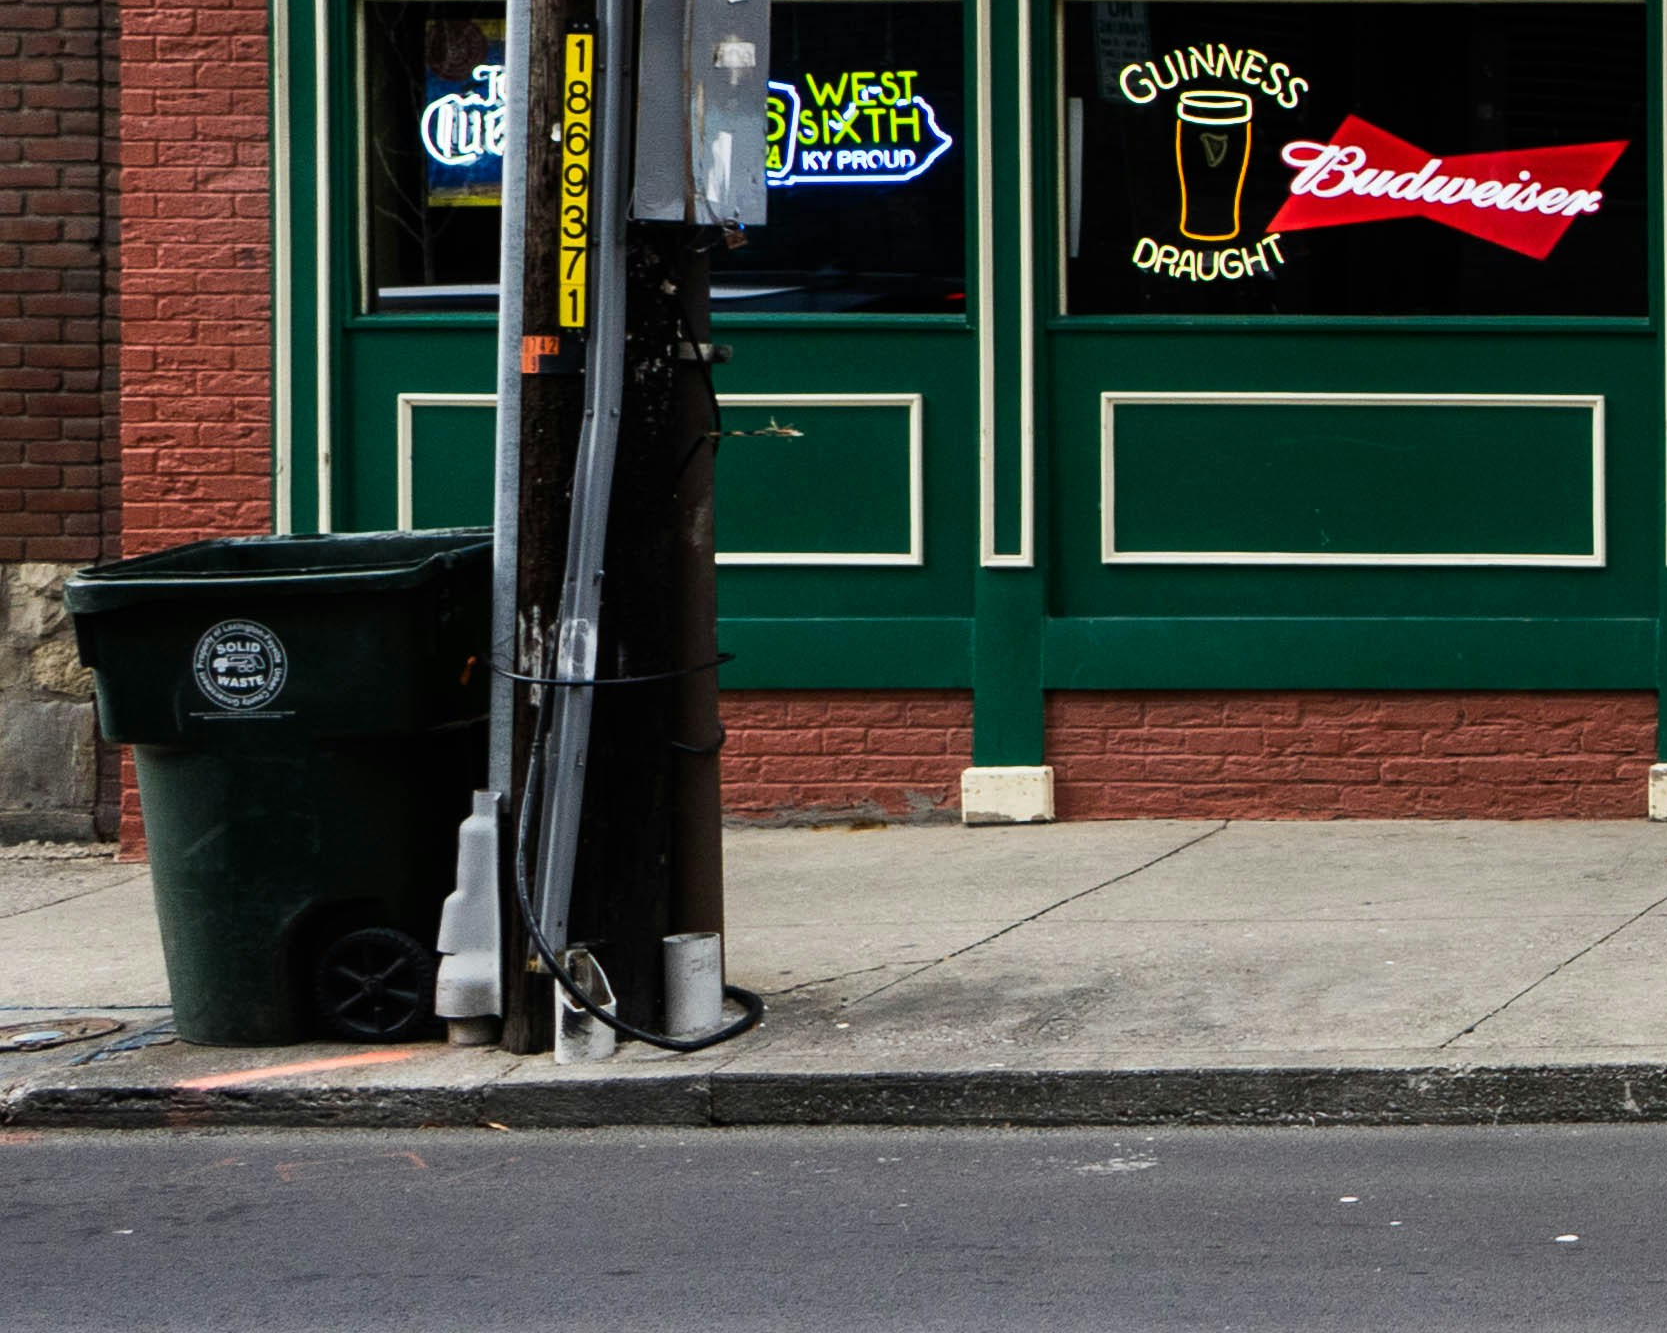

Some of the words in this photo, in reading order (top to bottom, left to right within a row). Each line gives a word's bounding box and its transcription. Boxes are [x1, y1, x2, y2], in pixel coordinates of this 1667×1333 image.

[805, 70, 918, 107] WEST
[1118, 43, 1308, 110] GUINNESS
[797, 108, 920, 145] SIXTH
[801, 149, 832, 170] KY
[836, 149, 916, 170] PROUD
[562, 38, 590, 323] 1869371
[1281, 141, 1602, 217] Budweiser
[1132, 232, 1285, 282] DRAUGHT
[216, 641, 261, 654] SOLID
[217, 674, 265, 688] WASTE
